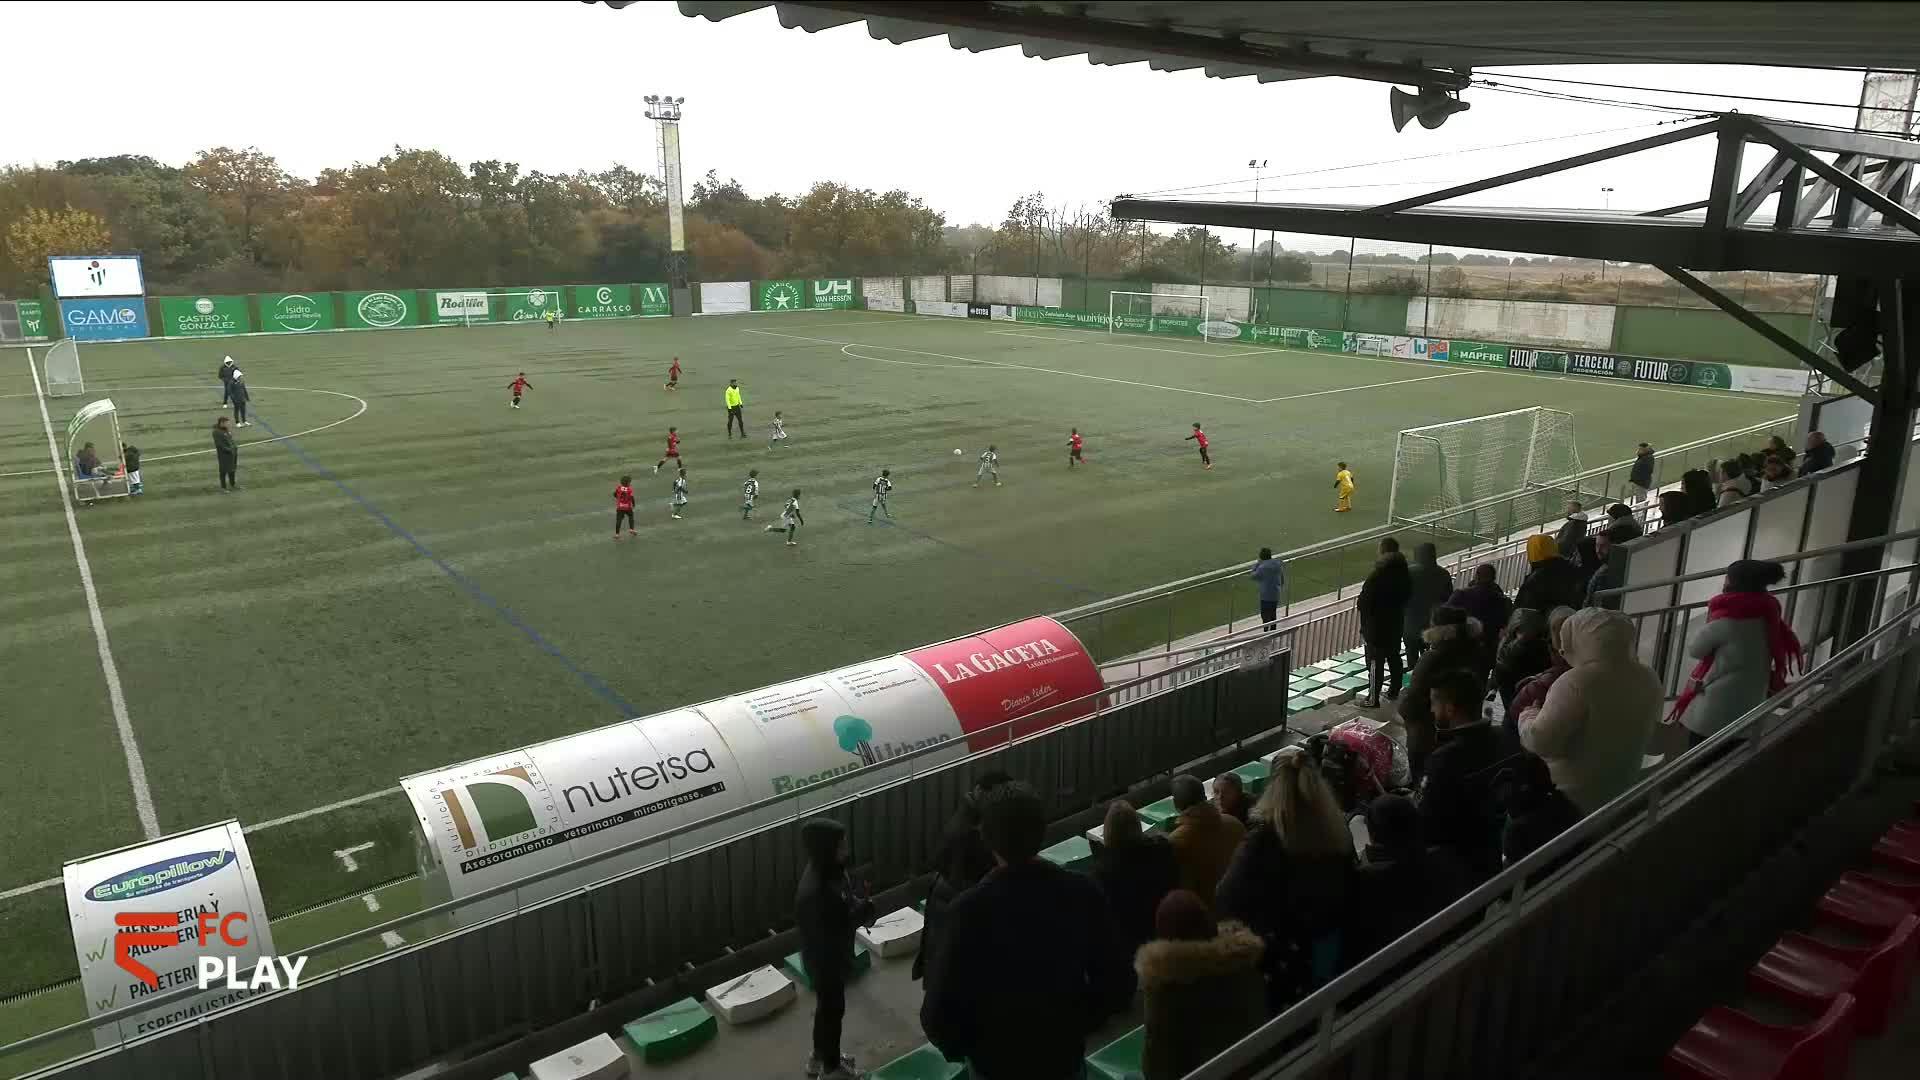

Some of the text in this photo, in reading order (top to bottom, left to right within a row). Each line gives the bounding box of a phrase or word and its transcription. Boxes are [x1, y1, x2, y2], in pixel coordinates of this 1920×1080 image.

[286, 305, 311, 314] Isidro
[441, 297, 484, 309] Rodilla
[577, 305, 632, 313] CARRASCO
[178, 314, 220, 323] CASTRO
[1414, 339, 1448, 359] lupa
[1459, 351, 1504, 362] MAPFRE
[1509, 349, 1539, 368] FUTUR
[1574, 354, 1615, 371] TERCERA
[1634, 360, 1669, 381] FUTUR
[933, 662, 978, 684] LA
[970, 638, 1061, 673] GACETA
[562, 747, 716, 814] nutersa
[464, 836, 554, 873] Asesoramiento
[563, 815, 625, 840] veterinario
[92, 848, 226, 899] Europillow
[211, 899, 219, 913] Y
